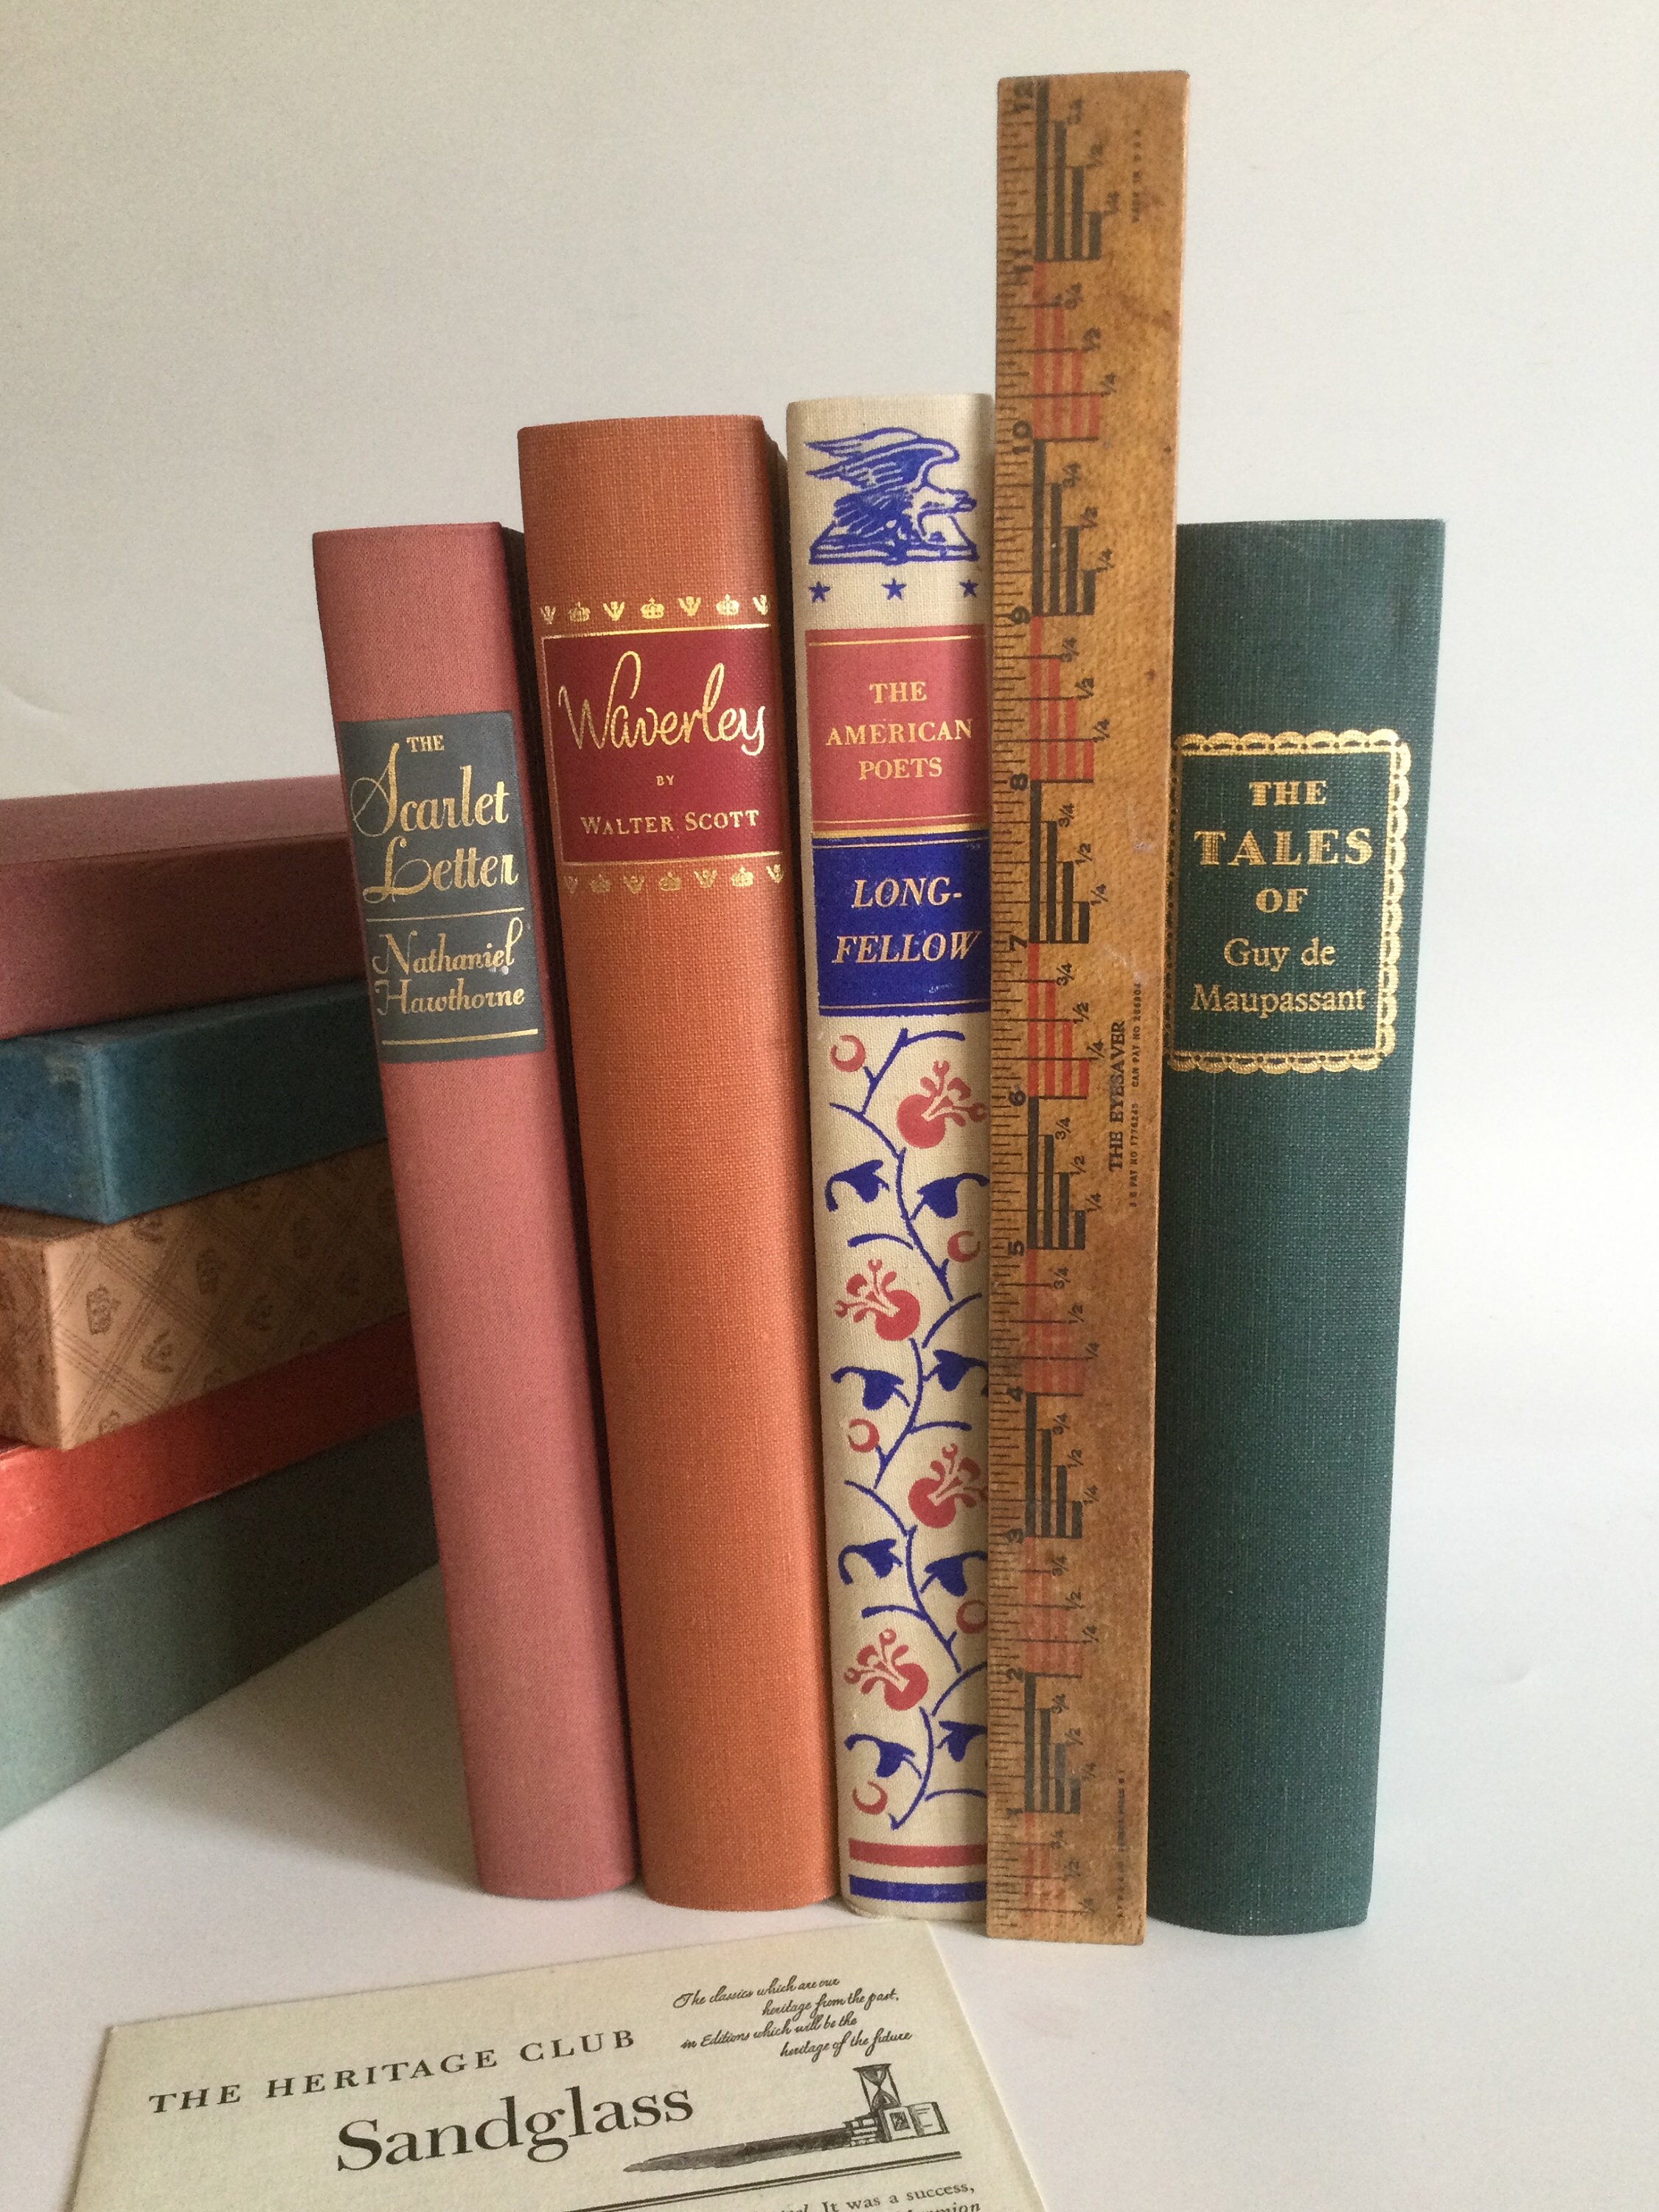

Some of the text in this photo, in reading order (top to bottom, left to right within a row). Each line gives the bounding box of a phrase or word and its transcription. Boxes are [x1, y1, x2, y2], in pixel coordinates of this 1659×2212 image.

[558, 651, 765, 756] Waverley
[869, 681, 928, 704] THE
[406, 735, 444, 753] THE
[825, 718, 972, 745] AMERICAN
[656, 775, 675, 786] BY
[858, 757, 942, 781] POETS
[1009, 773, 1029, 790] 8
[350, 743, 509, 837] Scarlet
[1249, 779, 1327, 806] THE
[580, 810, 759, 835] WALTER SCOTT
[1058, 803, 1075, 828] 3/4
[1074, 843, 1093, 866] 1/2
[1194, 827, 1374, 866] TALES
[363, 836, 518, 904] Letter
[851, 876, 963, 908] LONG-
[1090, 884, 1109, 906] 1/4
[1256, 888, 1308, 914] OF
[372, 917, 523, 975] Nathaniel
[831, 929, 981, 964] FELLOW
[1009, 934, 1028, 952] 7
[1223, 938, 1337, 972] Guy de
[1056, 963, 1075, 987] 3/4
[374, 978, 524, 1016] Hawthorne
[1191, 984, 1366, 1018] Maupassant
[1072, 1002, 1089, 1023] 1/2
[1086, 1039, 1105, 1062] 1/4
[1008, 1086, 1026, 1106] 6
[1109, 1020, 1124, 1172] THE EYESAVER
[1054, 1117, 1071, 1141] 3/4
[1070, 1155, 1086, 1177] 1/2
[1085, 1192, 1102, 1213] 1/4
[1008, 1240, 1025, 1256] 5
[1054, 1267, 1071, 1289] 3/4
[1068, 1304, 1085, 1324] 1/2
[1084, 1342, 1100, 1361] 1/4
[1053, 1413, 1071, 1435] 3/4
[1067, 1449, 1084, 1469] 1/2
[1082, 1485, 1099, 1505] 1/4
[672, 1975, 841, 2008] The classics which are our
[762, 2000, 812, 2022] heritage
[810, 1993, 846, 2019] from
[848, 1987, 865, 2004] the
[681, 2011, 858, 2049] in Editions which will be the
[779, 2027, 913, 2063] heritage of the future
[149, 2029, 635, 2113] THE HERITAGE CLUB
[337, 2084, 693, 2172] Sandglass
[821, 2201, 839, 2212] It
[846, 2195, 881, 2211] was
[889, 2195, 899, 2204] a
[906, 2183, 975, 2201] success,
